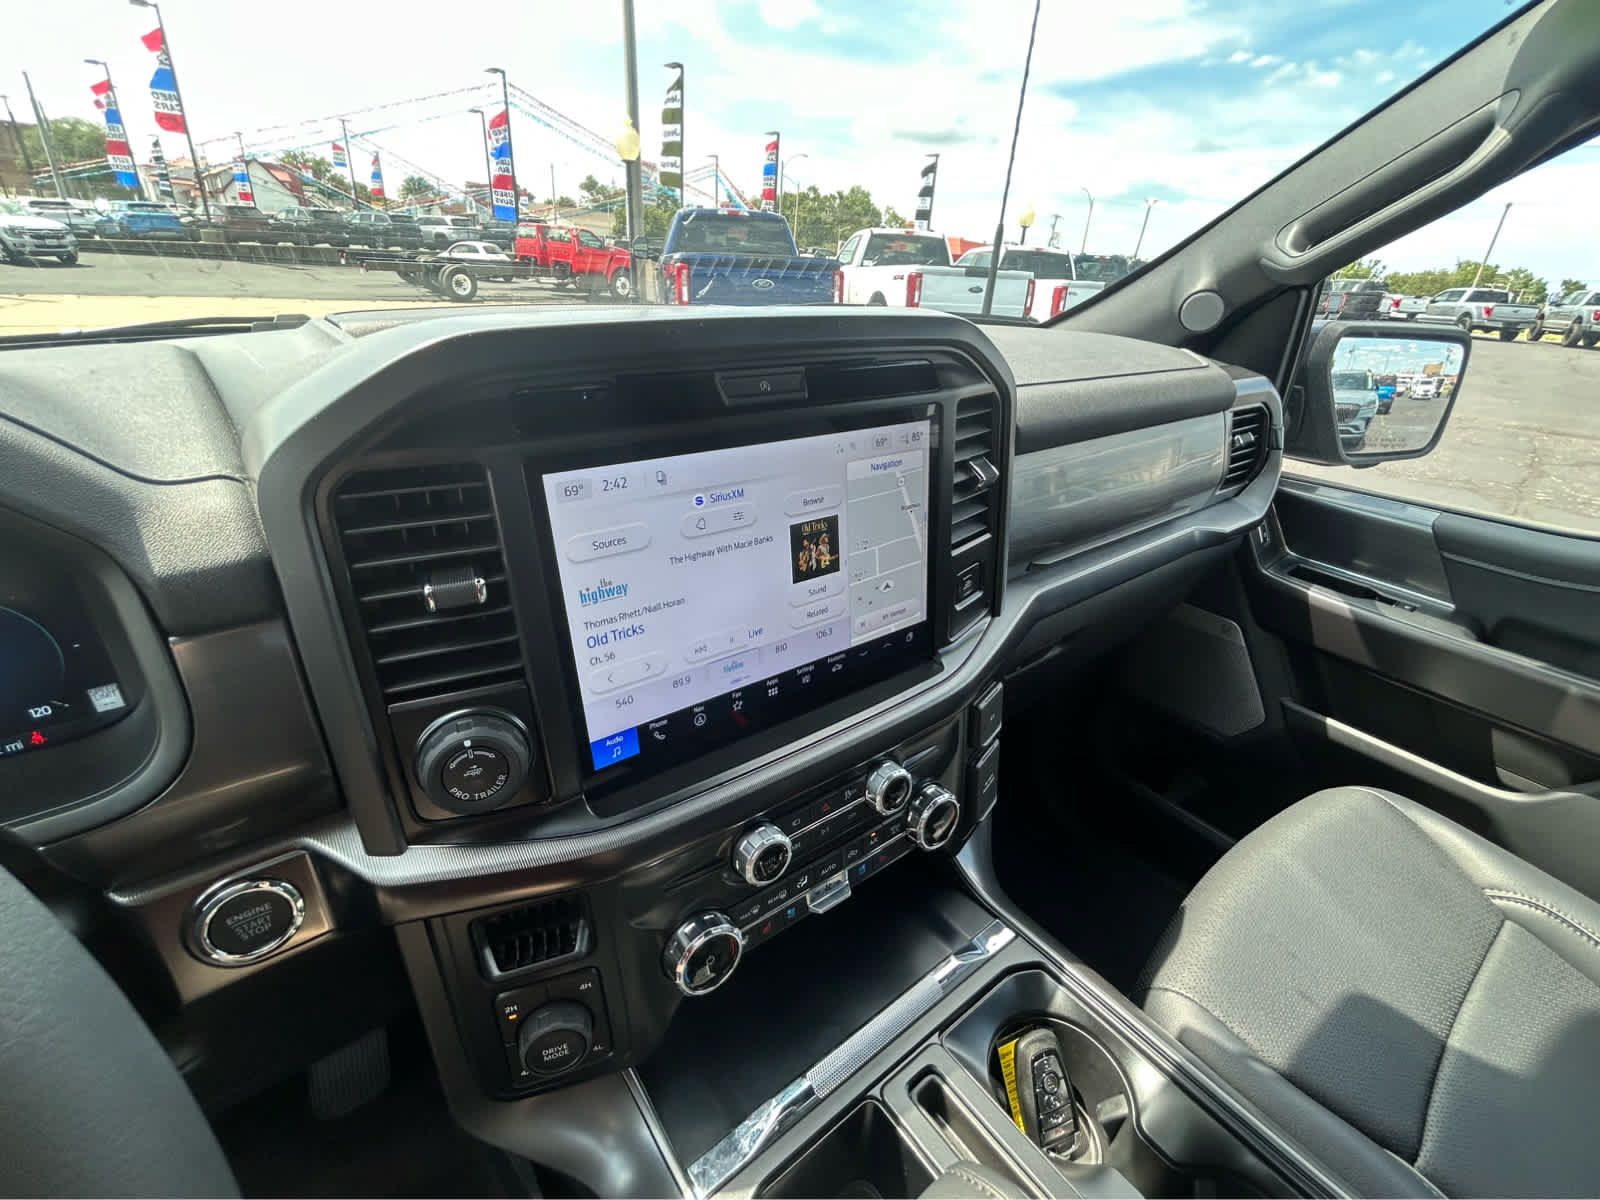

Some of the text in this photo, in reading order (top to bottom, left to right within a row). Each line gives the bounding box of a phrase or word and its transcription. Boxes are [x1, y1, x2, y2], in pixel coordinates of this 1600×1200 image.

[870, 459, 903, 472] Navigation
[602, 477, 628, 492] 2:42
[710, 488, 745, 503] SiriusXM
[802, 496, 825, 507] Browse
[592, 536, 627, 551] Sources
[669, 535, 774, 566] The Highway With Macie Banks
[600, 578, 613, 588] the
[578, 582, 629, 606] highway
[808, 584, 827, 596] Sound
[806, 606, 829, 618] Related
[584, 615, 619, 631] Thomas
[586, 624, 646, 649] Old Tricks
[748, 628, 763, 640] Live
[604, 651, 616, 661] 56
[615, 695, 634, 709] 540
[28, 705, 52, 718] 120
[6, 740, 24, 752] mi
[605, 735, 624, 746] Audio
[449, 773, 508, 801] PRO TRAILER
[821, 863, 837, 876] AUTO
[225, 902, 273, 926] ENGINE
[235, 914, 272, 936] START
[240, 922, 272, 942] STOP
[504, 1004, 518, 1014] 2H
[542, 1042, 568, 1056] DRIVE
[543, 1049, 569, 1062] MODE
